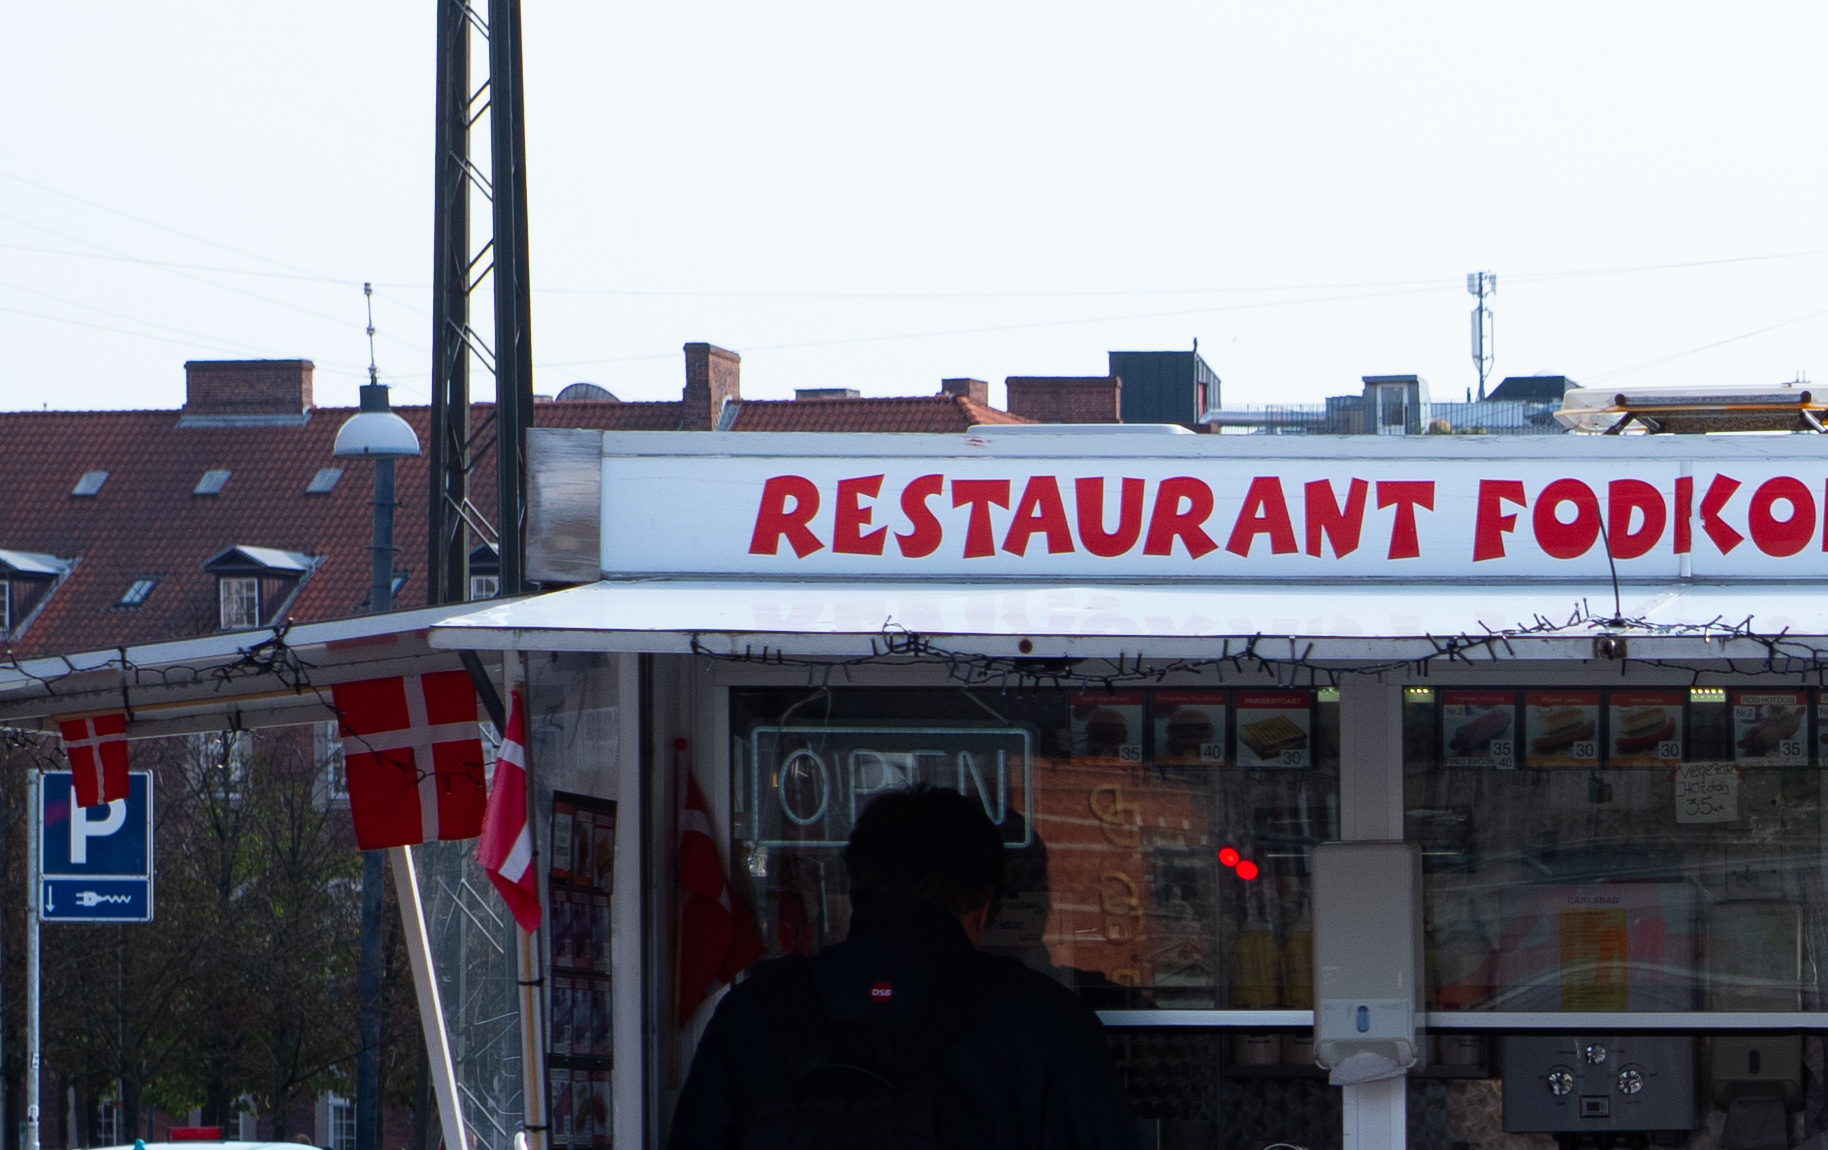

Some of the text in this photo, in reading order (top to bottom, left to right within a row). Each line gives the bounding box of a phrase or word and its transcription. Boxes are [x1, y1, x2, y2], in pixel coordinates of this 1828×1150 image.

[748, 474, 1435, 560] RESTAURANT
[1243, 697, 1302, 705] PARISERTOAST
[1736, 708, 1753, 716] Nr.2
[1121, 746, 1140, 761] 35
[1203, 745, 1221, 759] 40
[1492, 742, 1511, 756] 35
[1576, 743, 1595, 758] 30
[1661, 743, 1680, 758] 30
[1782, 742, 1800, 756] 35
[1282, 751, 1301, 765] 30
[1499, 757, 1513, 768] 40
[69, 783, 128, 865] P
[1567, 896, 1619, 904] CARLSBAD
[871, 988, 892, 997] DSB
